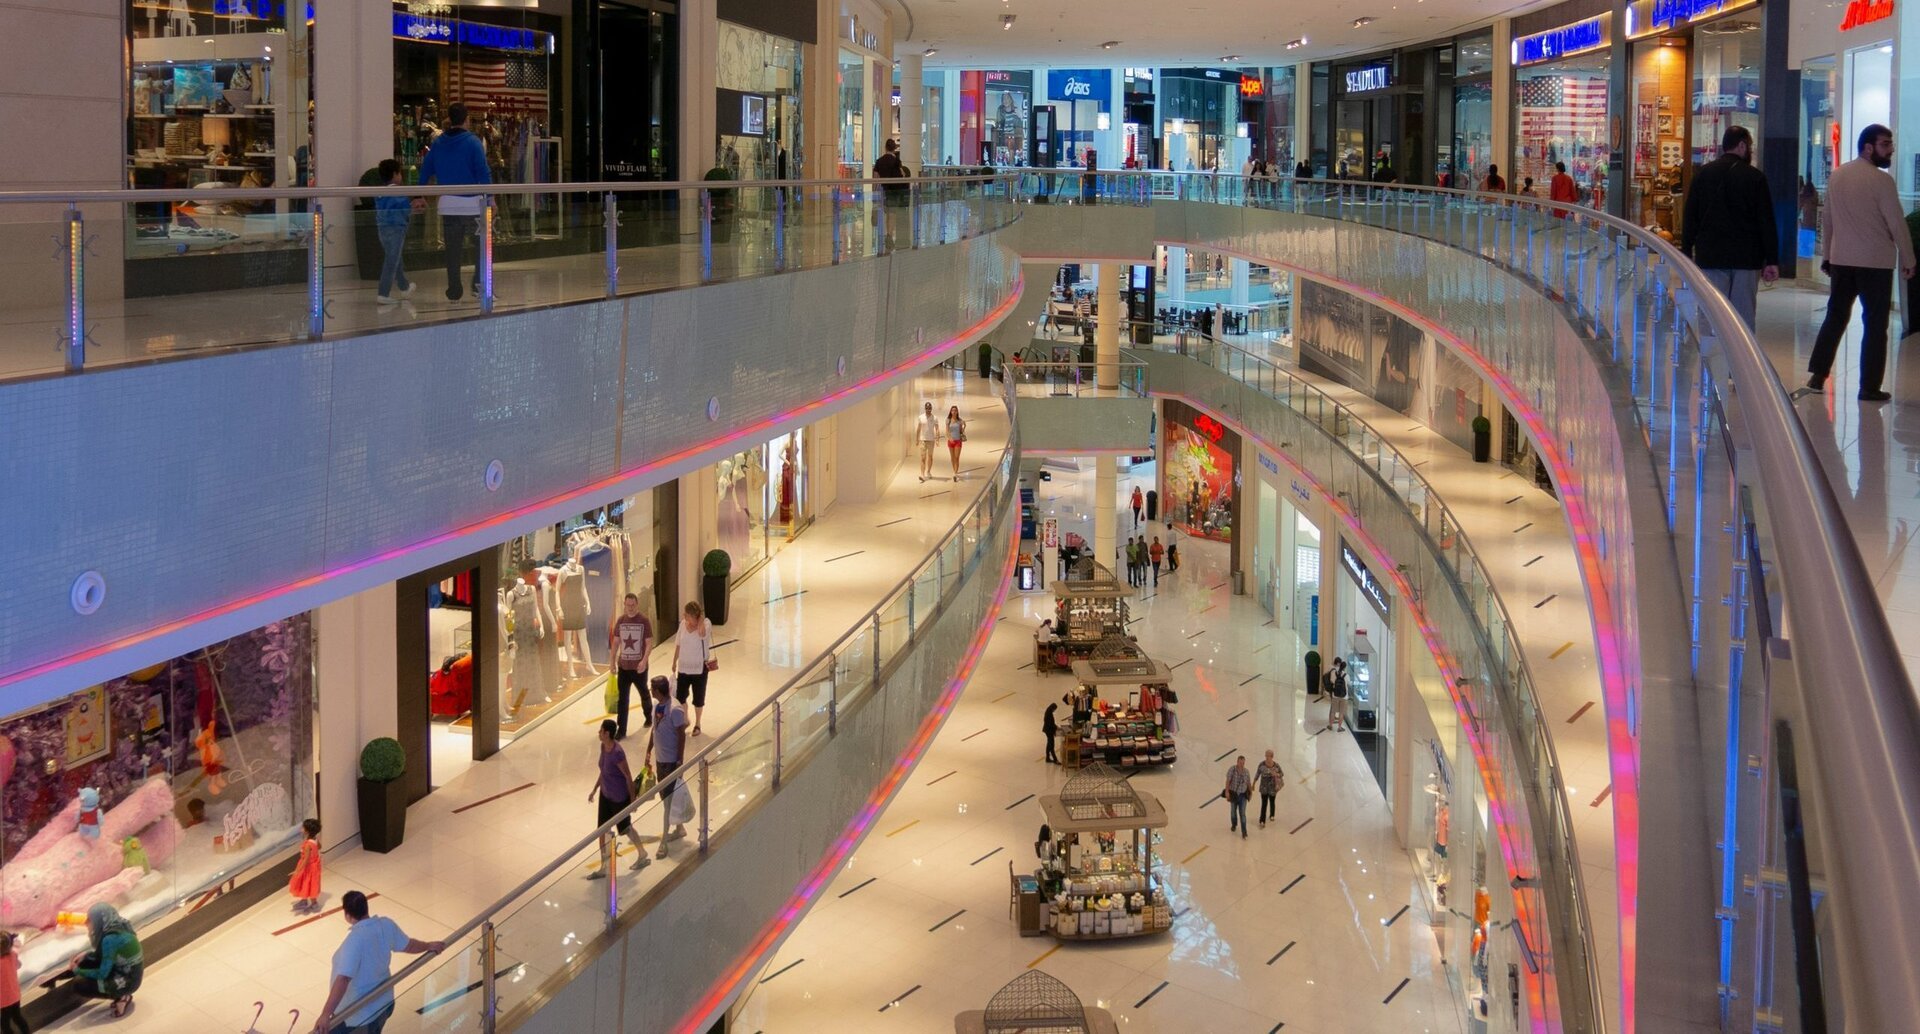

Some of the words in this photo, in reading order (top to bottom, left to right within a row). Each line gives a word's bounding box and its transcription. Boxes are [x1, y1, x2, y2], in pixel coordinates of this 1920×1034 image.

[1345, 66, 1387, 93] STADIUM
[605, 164, 625, 172] VIVID
[626, 165, 647, 173] FLAIR
